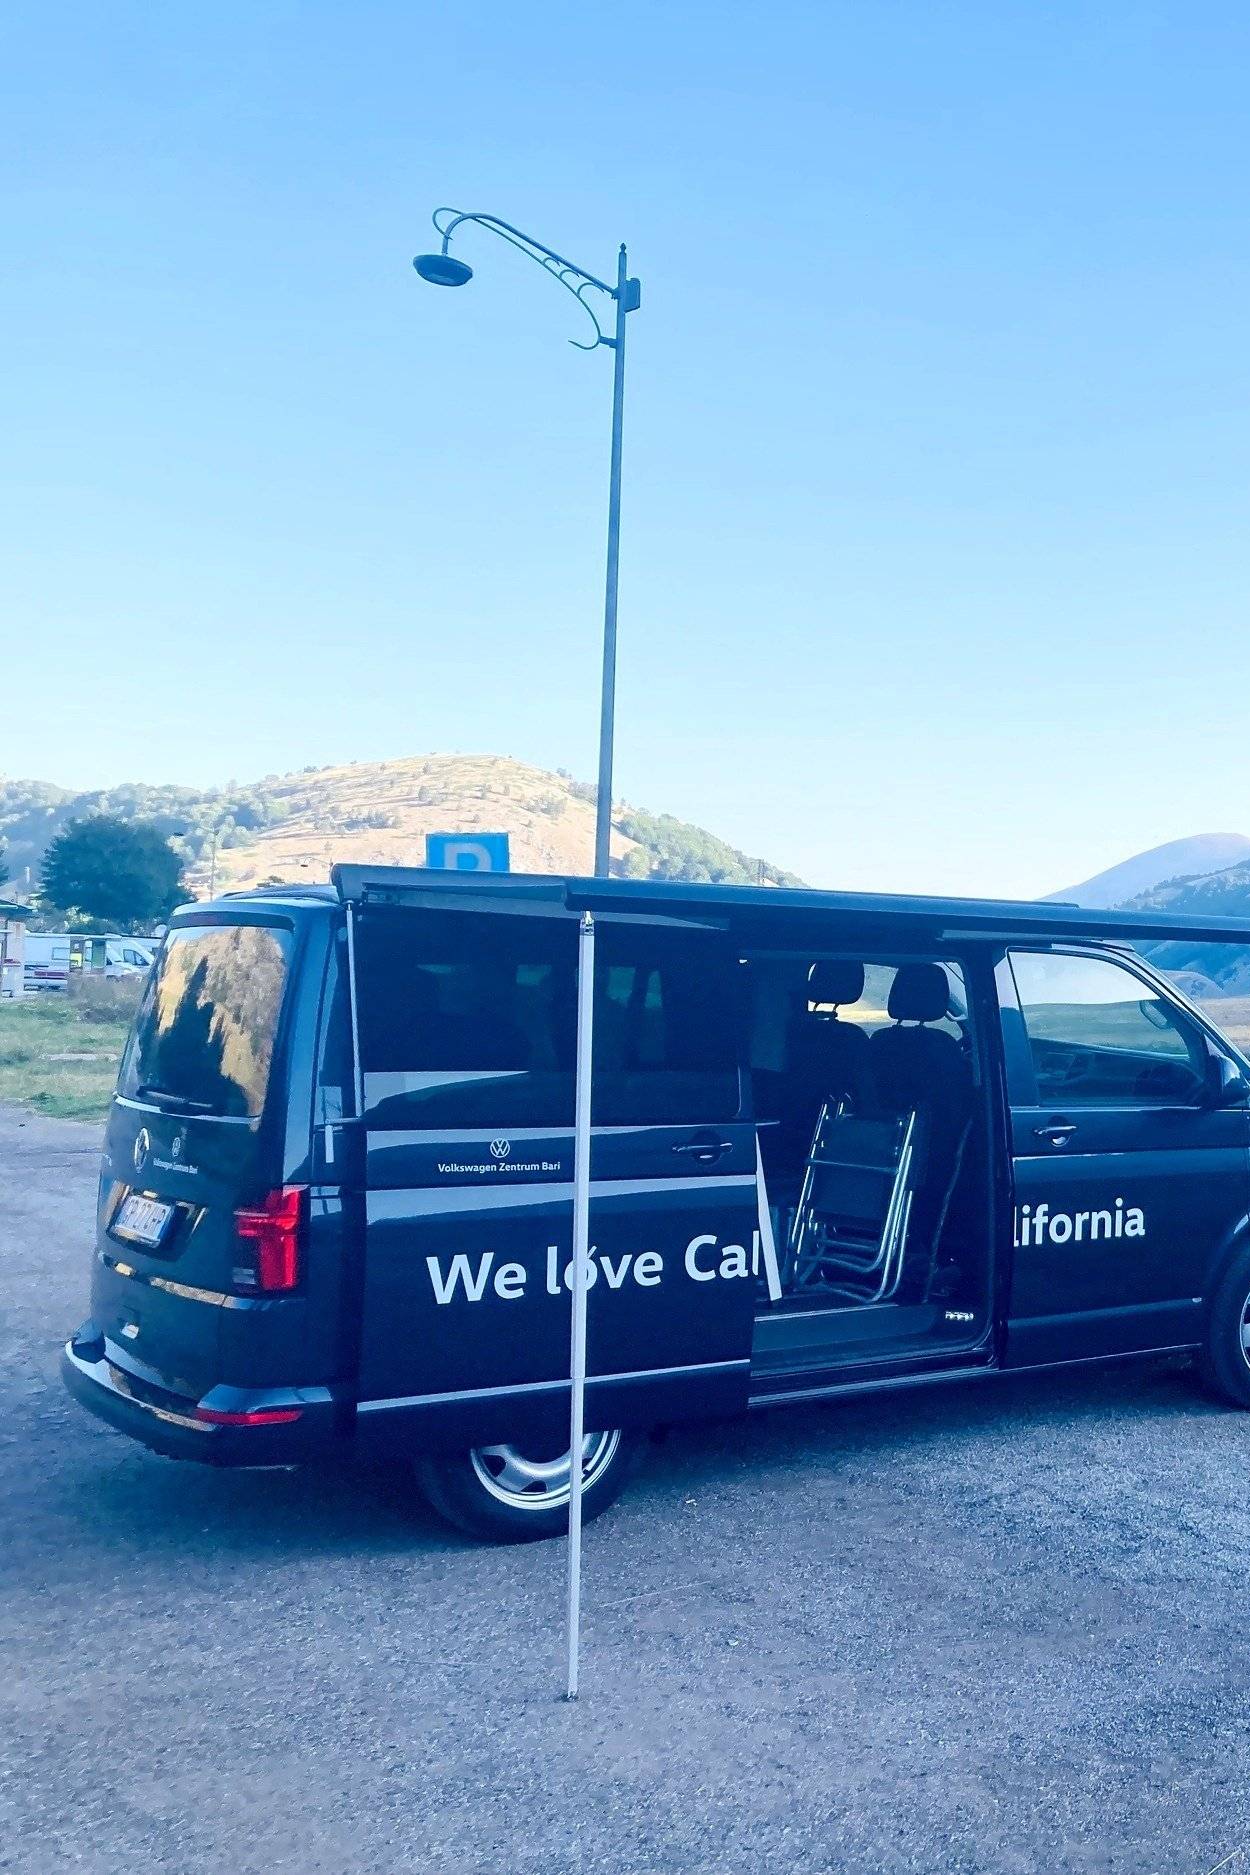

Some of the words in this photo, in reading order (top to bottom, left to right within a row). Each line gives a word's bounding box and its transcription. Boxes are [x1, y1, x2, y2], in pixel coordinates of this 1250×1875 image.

[438, 1163, 497, 1173] Volkswagen
[499, 1162, 540, 1171] Zentrum
[542, 1162, 561, 1171] Bari
[426, 1252, 527, 1304] We
